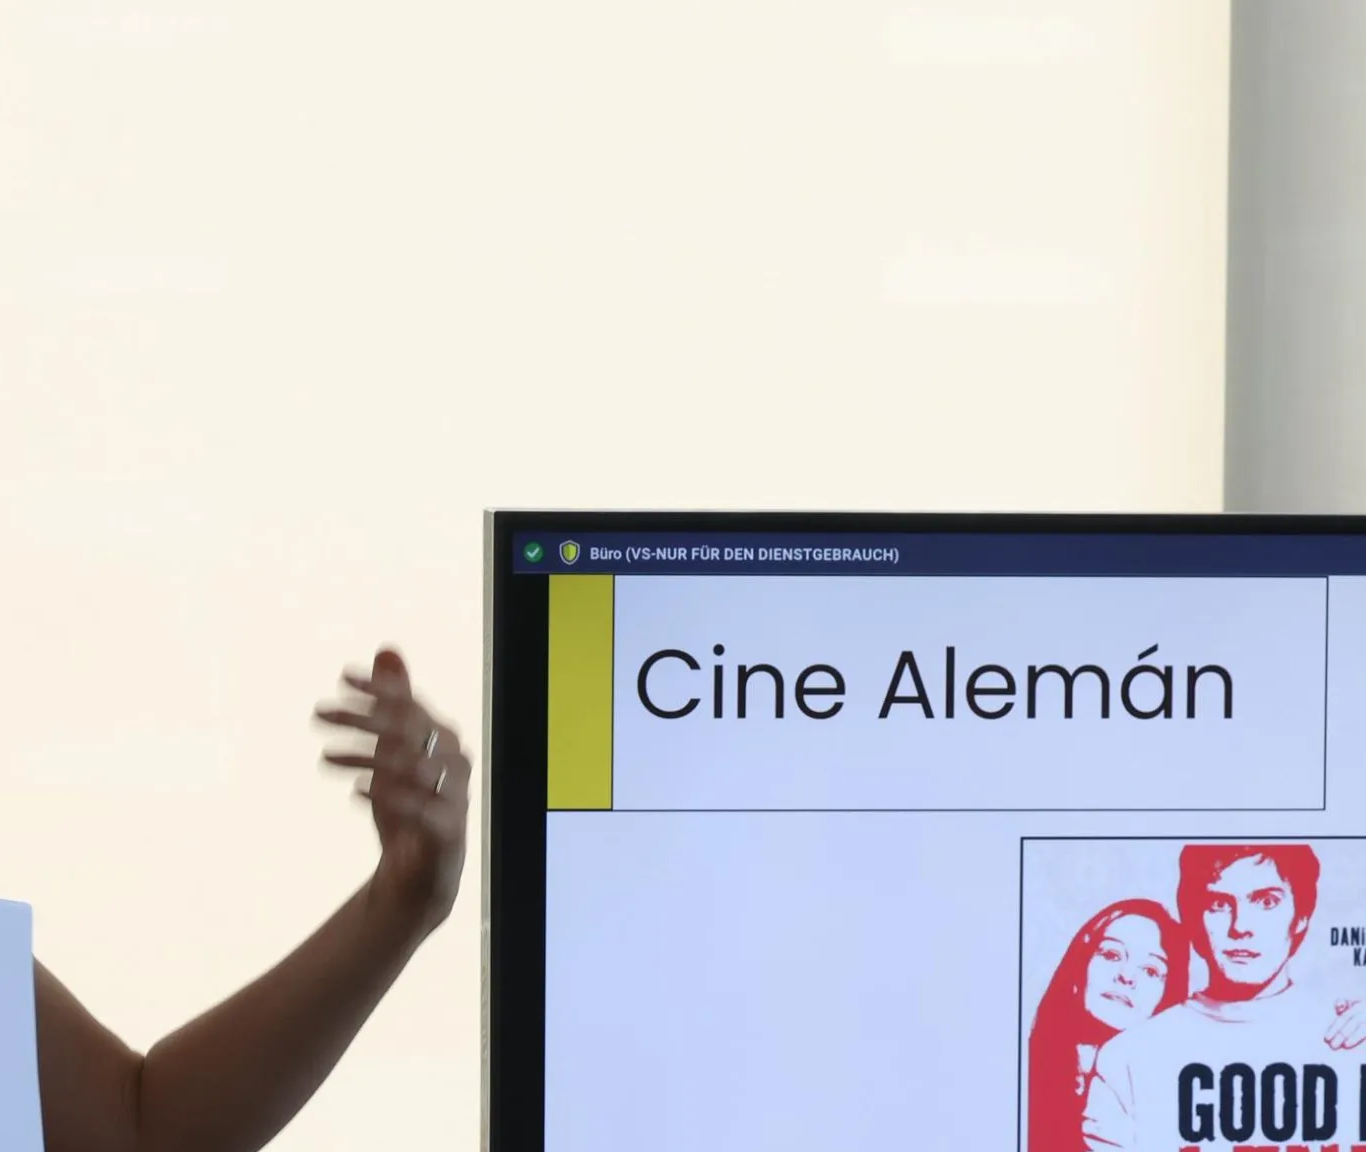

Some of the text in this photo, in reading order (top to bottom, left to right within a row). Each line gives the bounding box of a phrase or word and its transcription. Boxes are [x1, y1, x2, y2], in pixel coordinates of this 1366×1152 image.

[590, 546, 899, 563] Büro (VS-NUR FÜR DEN DIENSTGEBRAUCH)
[637, 644, 1234, 719] Cine Alemán
[1178, 1062, 1338, 1143] GOOD
